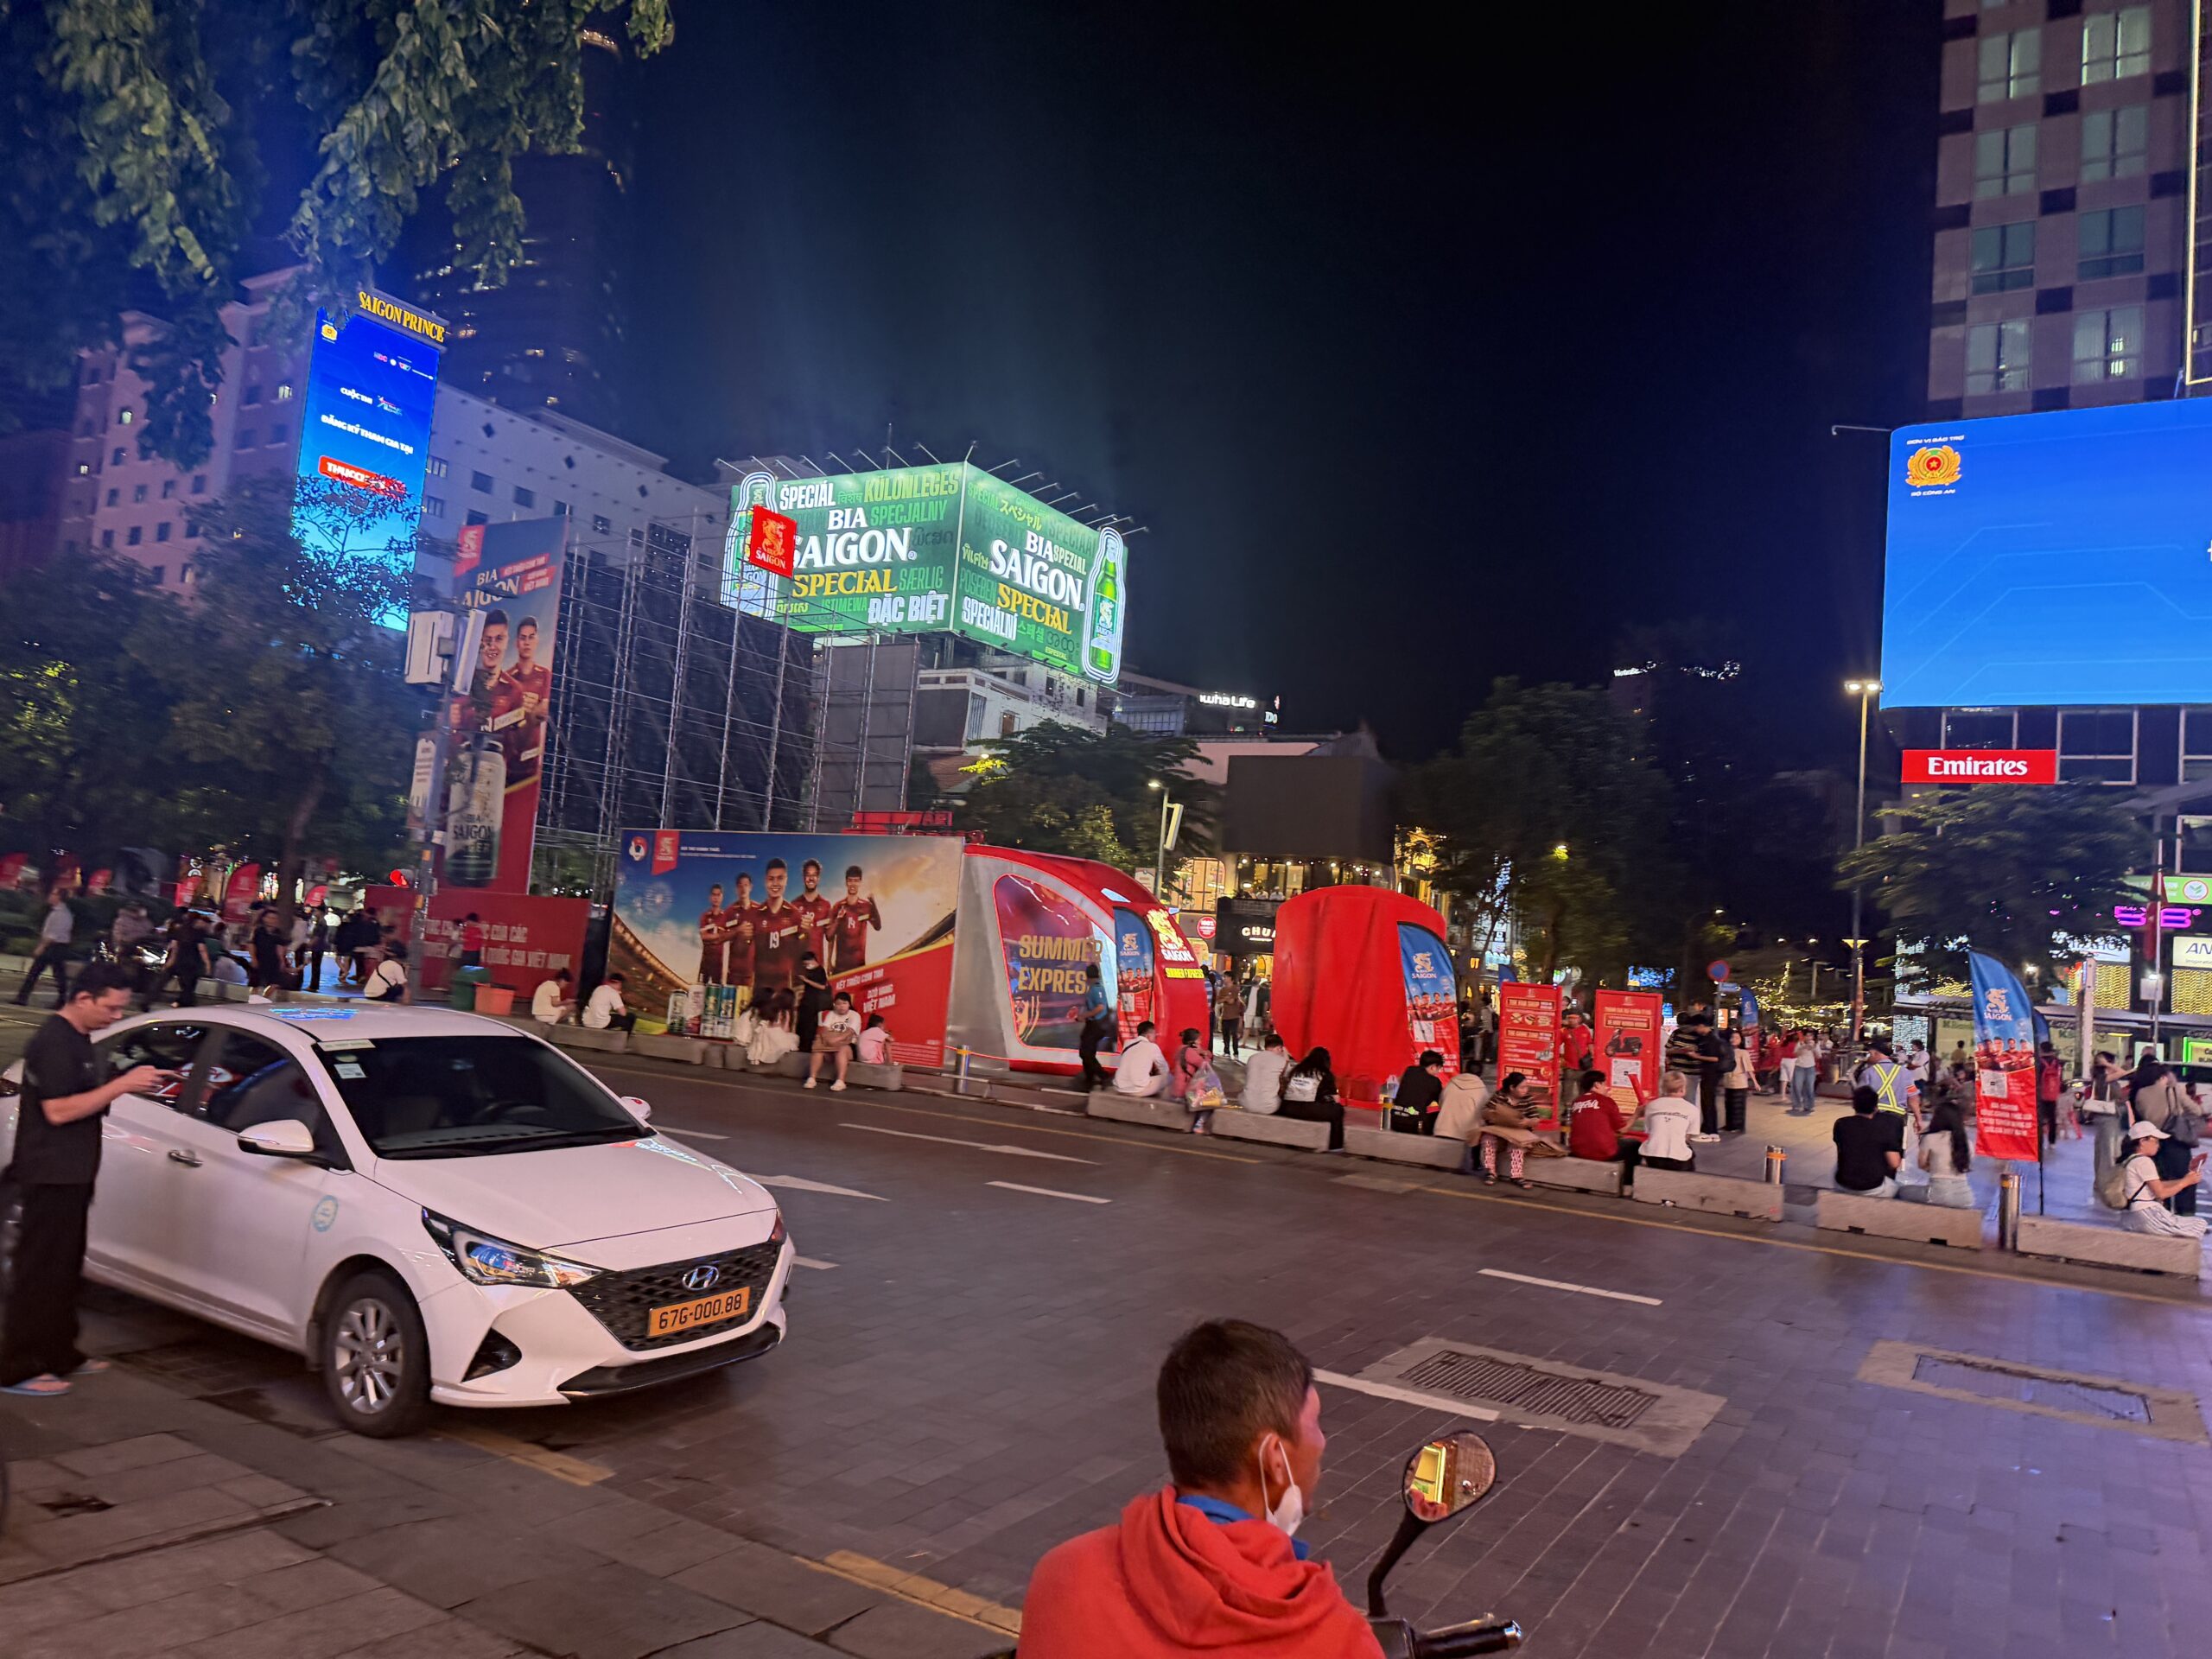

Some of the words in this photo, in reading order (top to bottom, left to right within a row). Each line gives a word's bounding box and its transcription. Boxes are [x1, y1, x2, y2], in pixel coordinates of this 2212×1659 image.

[359, 291, 403, 324] SAIGON
[403, 310, 445, 343] PRINCE
[828, 507, 868, 531] BIA
[870, 499, 947, 526] SPECJALNY
[1000, 499, 1042, 531] スペシャル
[756, 549, 787, 569] SAIGON
[1025, 531, 1054, 563] BIA
[1052, 544, 1087, 575] SPEZIAL
[477, 569, 498, 586] BIA
[792, 569, 898, 597] SPECIAL
[989, 538, 1084, 610] SAIGON
[868, 593, 906, 626] ĐẶC
[907, 589, 950, 625] BIỆT
[997, 582, 1072, 635] SPECIAL
[1928, 756, 2028, 776] Emirates
[769, 931, 779, 949] 19
[1020, 935, 1103, 963] SUMMER
[1160, 949, 1195, 962] SAIGON
[1018, 967, 1090, 995] EXPRES
[1984, 1010, 2012, 1020] SAIGON
[658, 1294, 742, 1329] 67G-000.88
